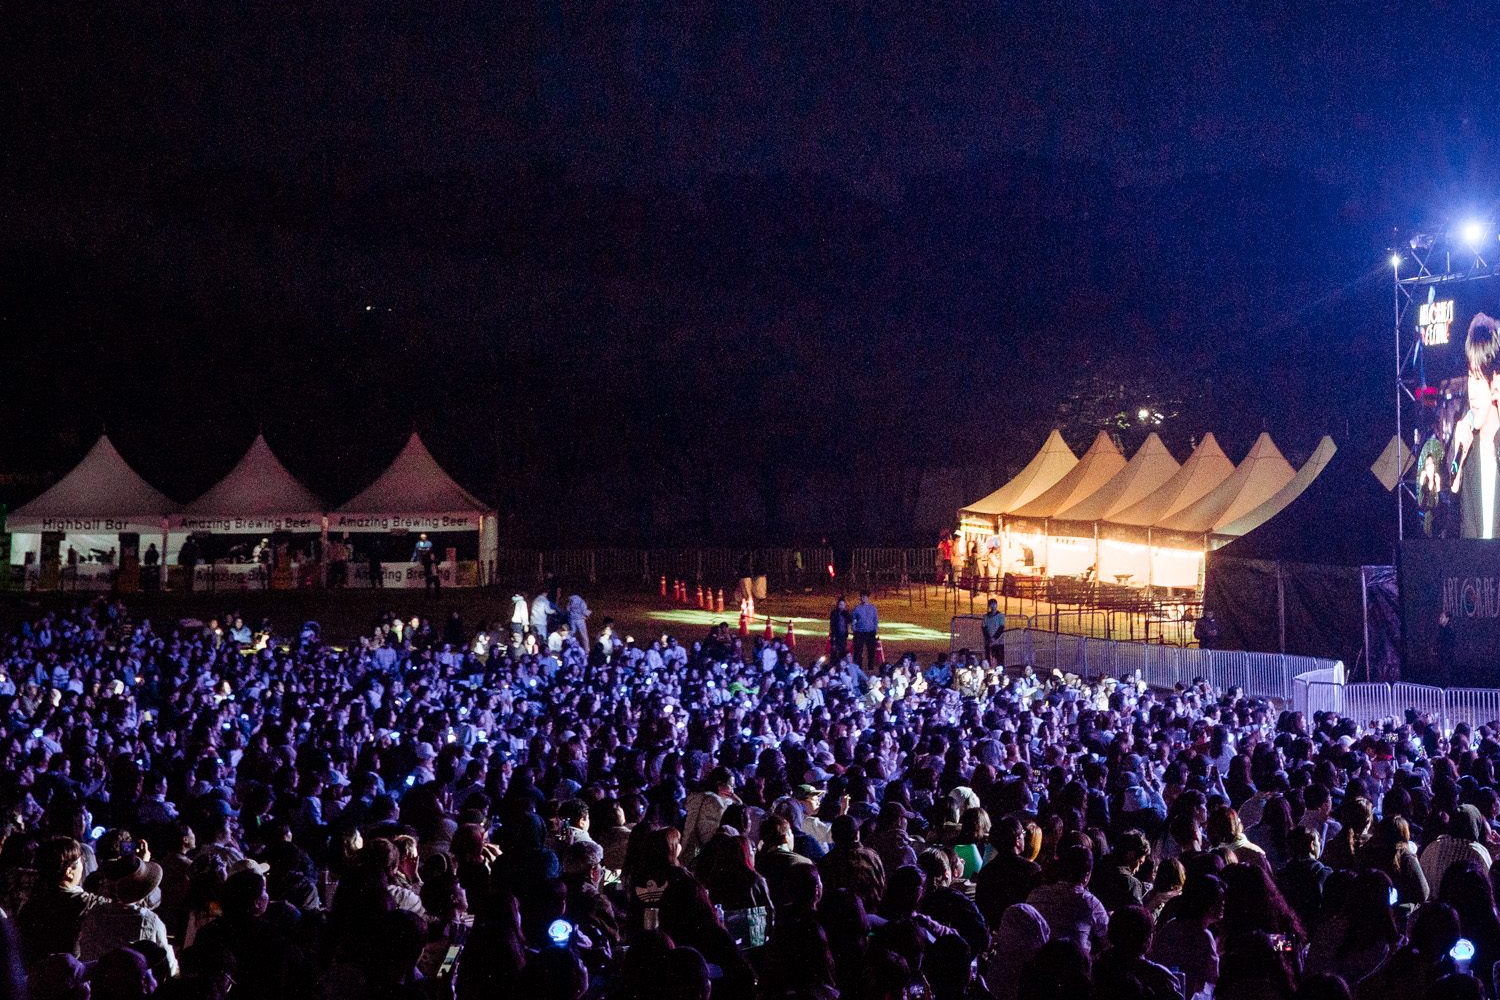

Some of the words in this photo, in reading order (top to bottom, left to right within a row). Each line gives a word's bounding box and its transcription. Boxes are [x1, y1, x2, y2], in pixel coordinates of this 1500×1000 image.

[42, 518, 100, 532] Highball
[105, 518, 129, 530] Bar
[180, 516, 231, 530] Amazing
[235, 516, 281, 530] Brewing
[285, 516, 311, 529] Beer
[338, 515, 388, 529] Amazing
[393, 515, 439, 529] Brewing
[442, 515, 468, 528] Beer
